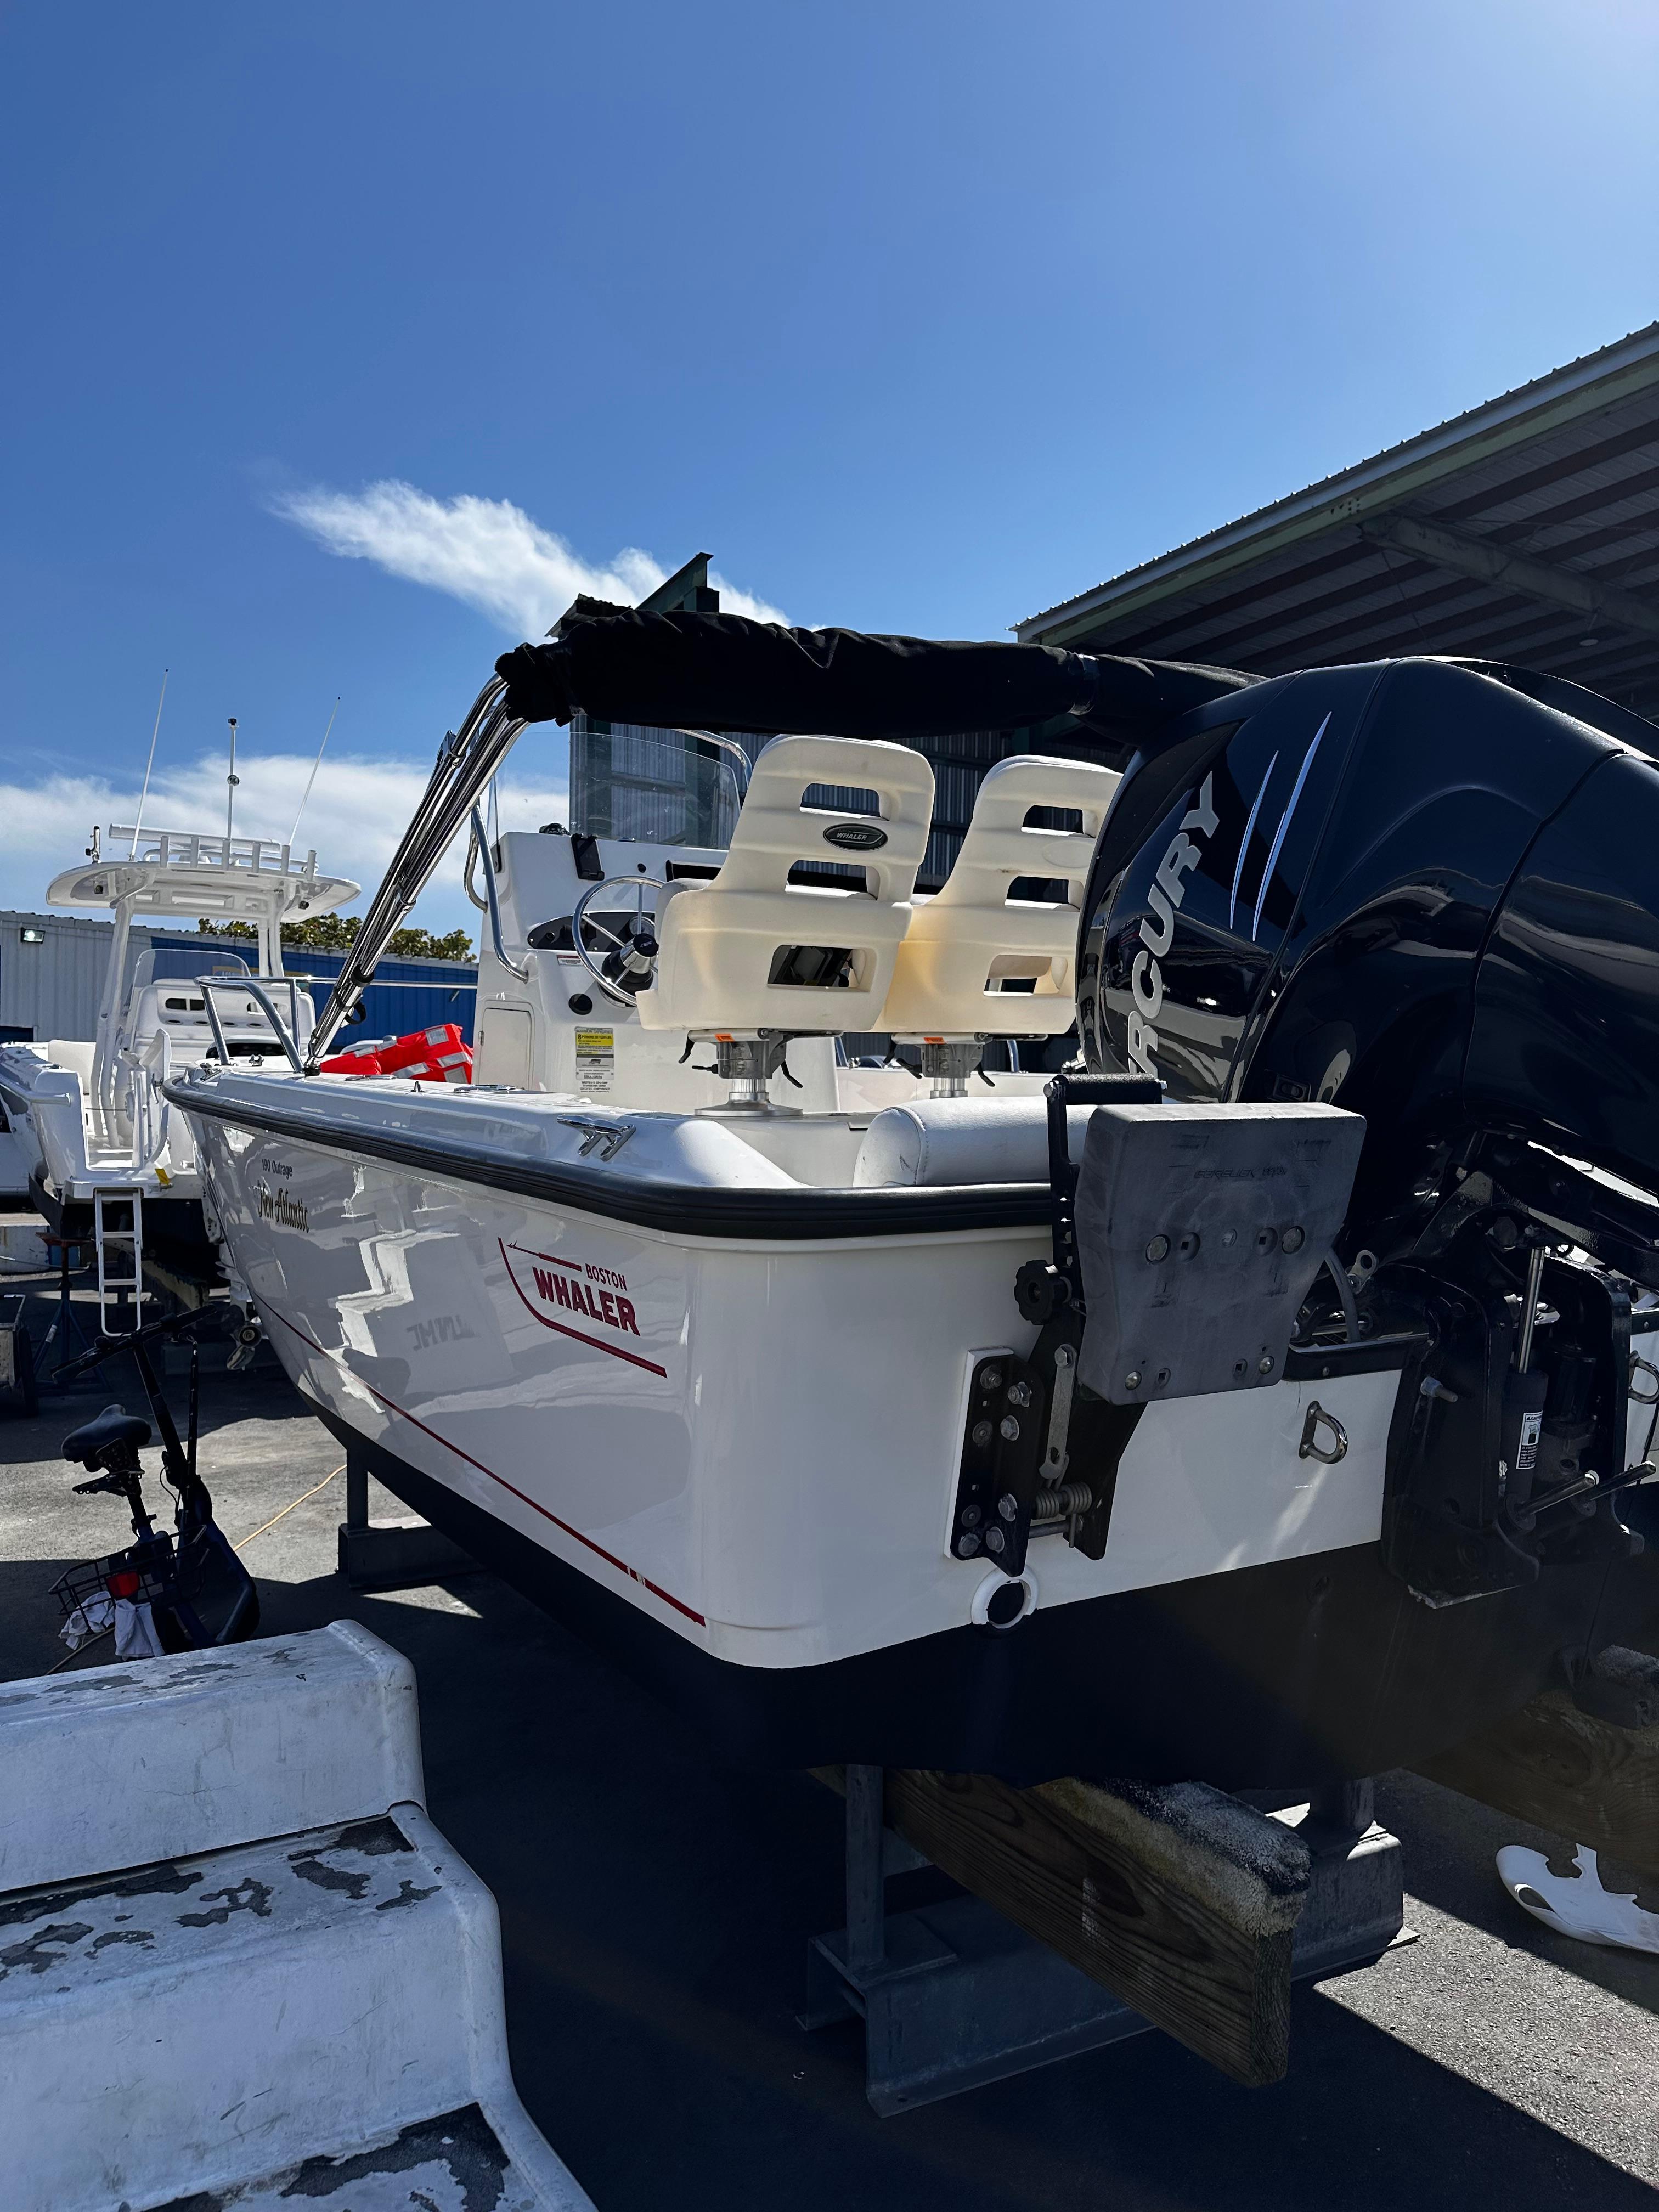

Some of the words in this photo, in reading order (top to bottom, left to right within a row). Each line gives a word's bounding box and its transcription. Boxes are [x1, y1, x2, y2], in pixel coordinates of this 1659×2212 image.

[836, 832, 867, 840] WHALER
[1128, 771, 1220, 1080] RCURY
[262, 1158, 271, 1172] 190
[272, 1160, 293, 1180] Outrage
[257, 1180, 274, 1220] New
[275, 1187, 309, 1233] Atlantic
[585, 1263, 628, 1291] BOSTON
[532, 1266, 641, 1336] WHALER
